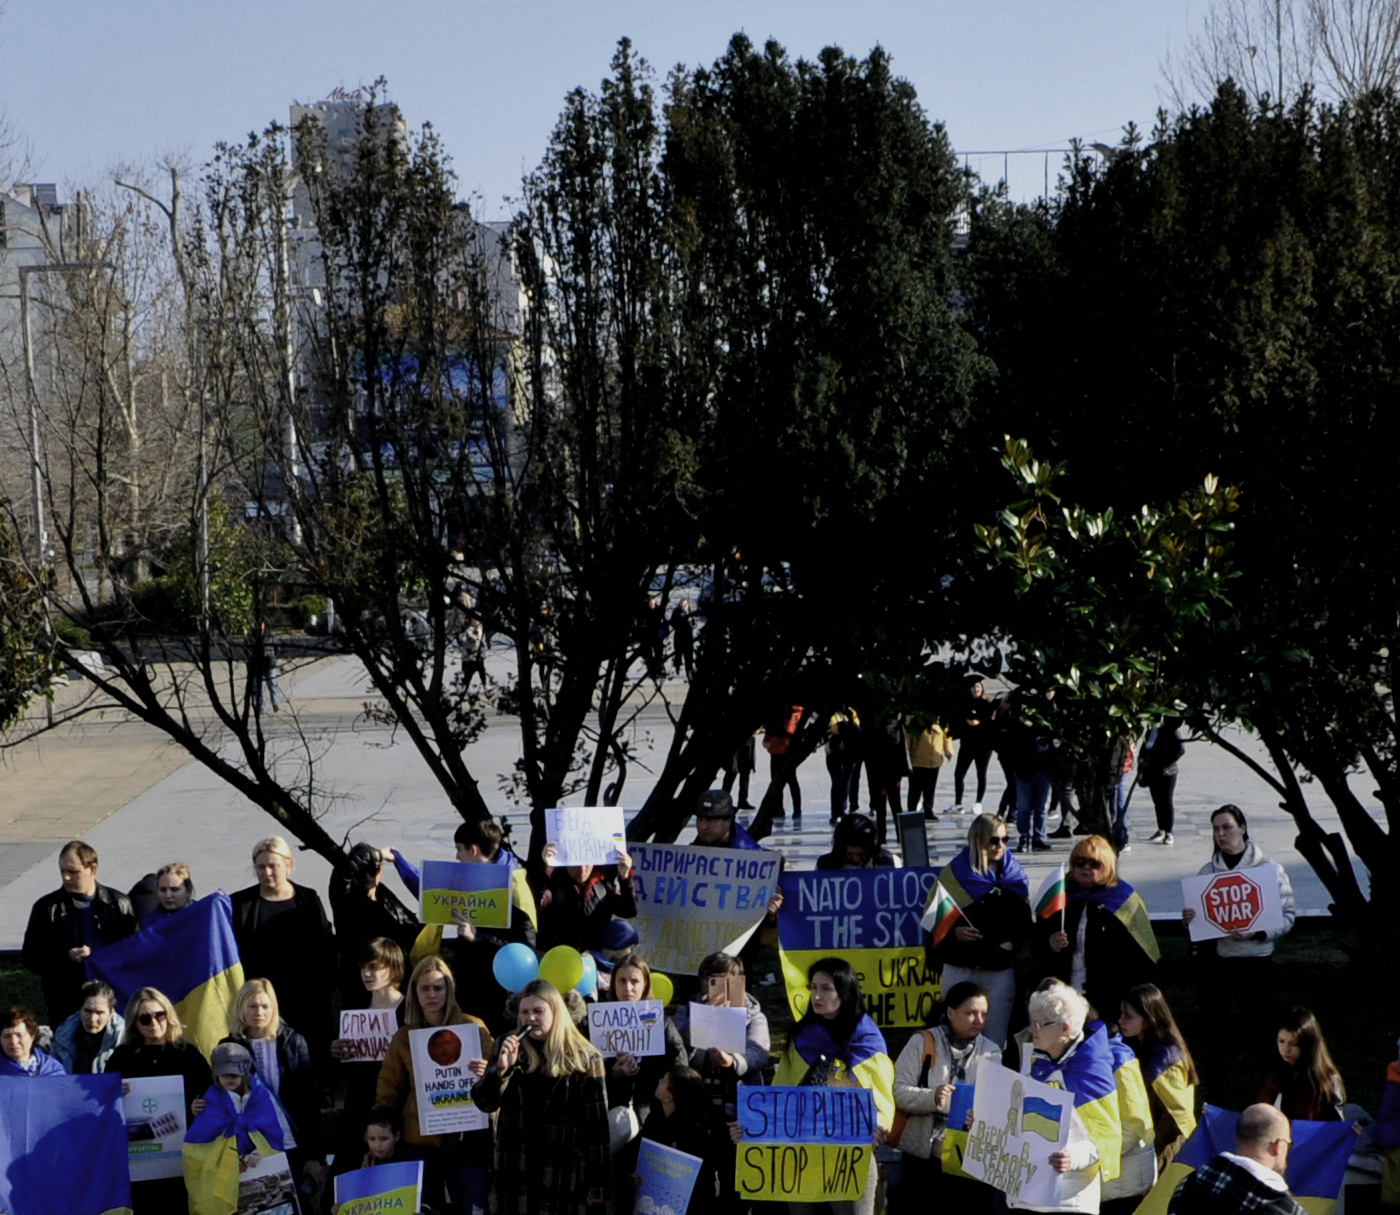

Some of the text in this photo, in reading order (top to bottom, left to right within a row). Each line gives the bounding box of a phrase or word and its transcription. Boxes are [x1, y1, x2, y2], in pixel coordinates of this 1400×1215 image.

[433, 894, 497, 909] УКРАЙНА
[798, 871, 938, 912] NATO CLOS
[1209, 883, 1252, 906] STOP
[451, 908, 478, 920] В ЕС
[1212, 902, 1254, 924] WAR
[806, 914, 864, 949] THE
[342, 1012, 389, 1036] СПРИ!
[592, 1005, 639, 1028] СЛАВА
[600, 1025, 651, 1053] УКРАЇНІ
[435, 1066, 462, 1079] PUTIN
[424, 1077, 475, 1093] HANDS OFF
[431, 1090, 469, 1106] UKRAINE
[744, 1090, 874, 1139] STOP PUTIN
[741, 1146, 809, 1195] STOP
[821, 1146, 864, 1195] WAR
